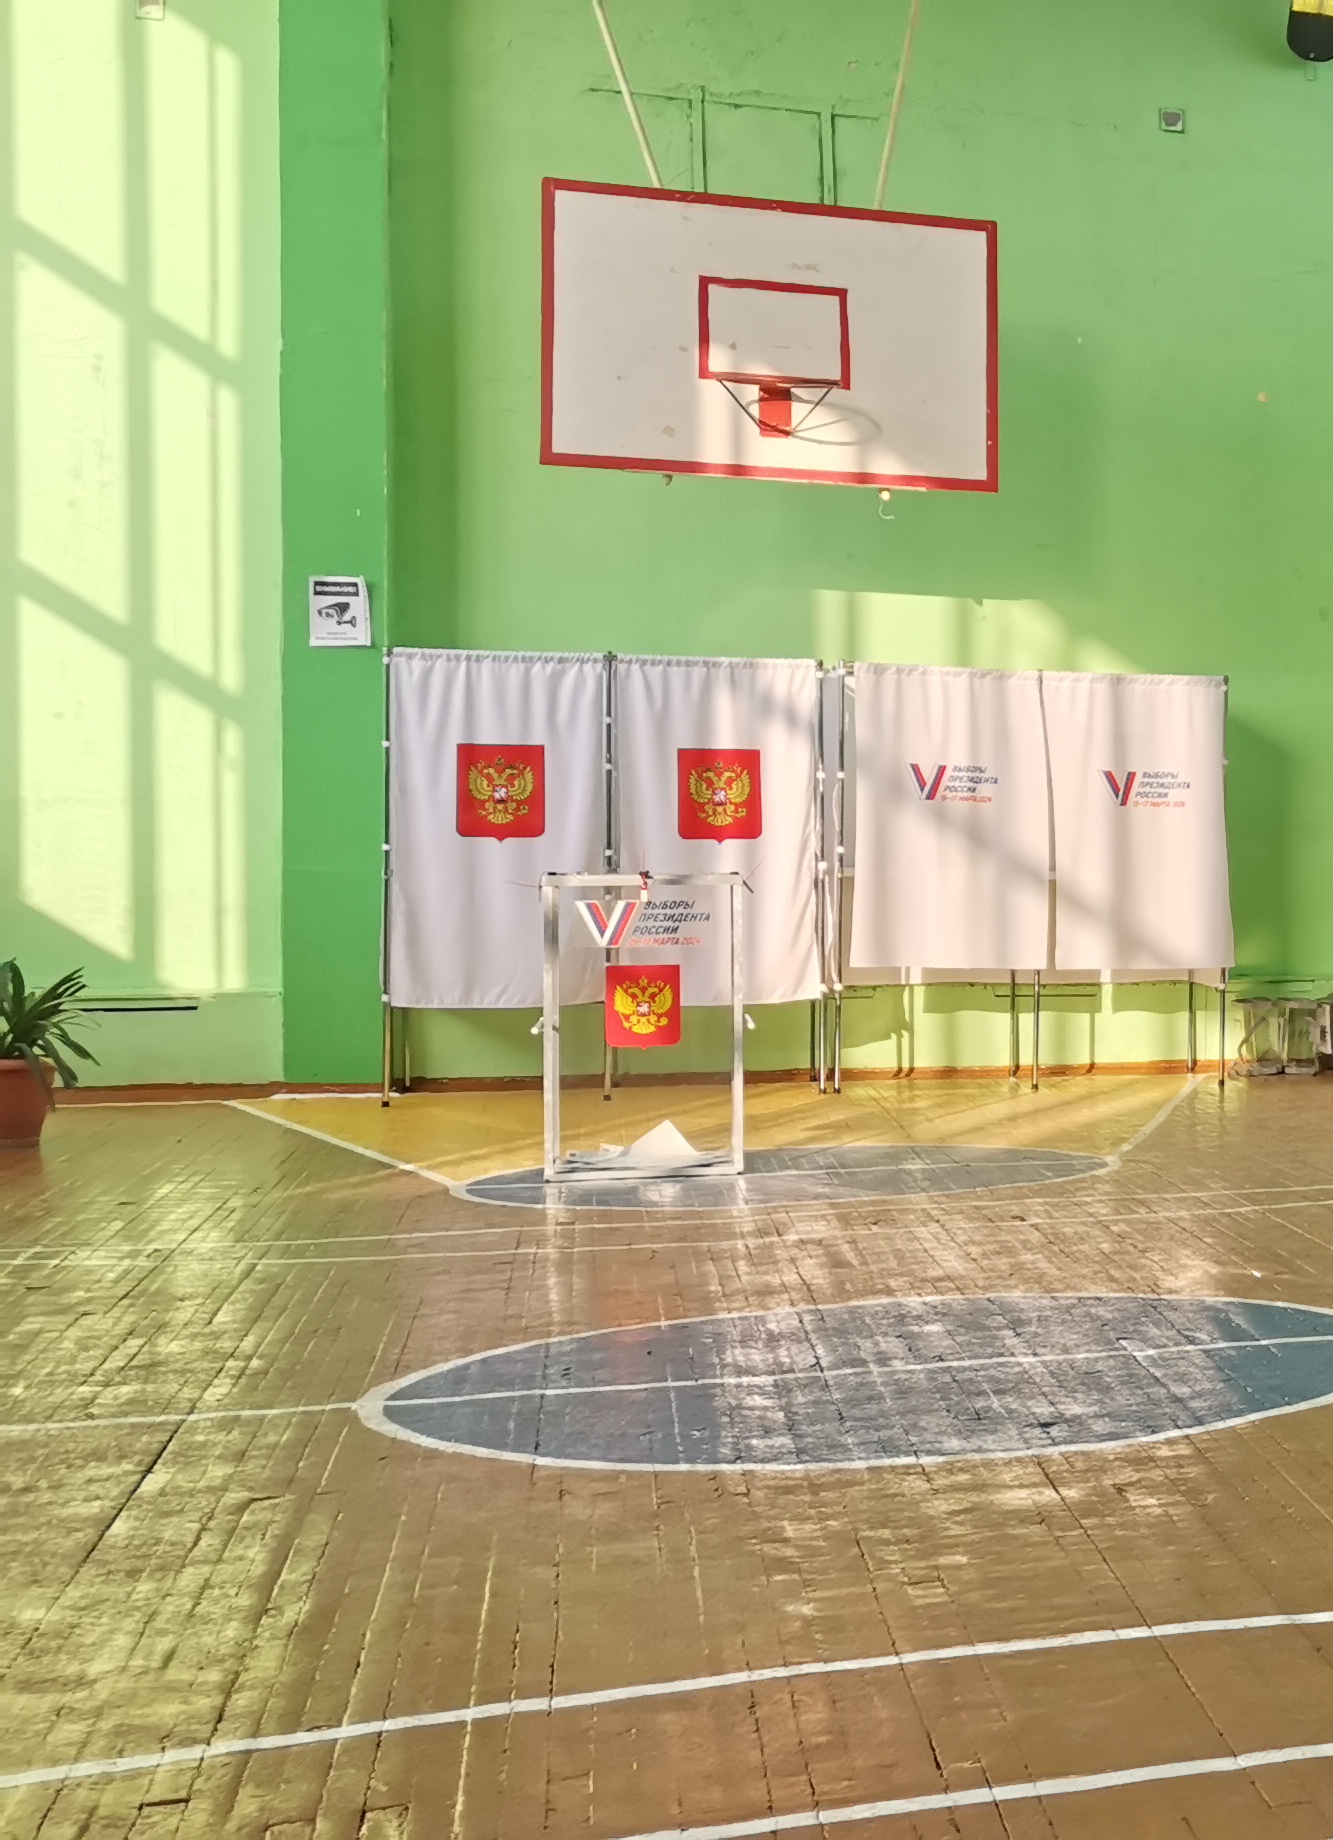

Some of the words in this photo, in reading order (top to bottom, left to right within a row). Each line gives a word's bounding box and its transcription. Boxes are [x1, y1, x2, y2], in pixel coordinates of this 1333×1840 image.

[1142, 771, 1179, 780] ВЫБОРЫ
[1138, 781, 1191, 790] ПРЕЗИДЕНТА
[1135, 791, 1169, 799] РОССИИ
[643, 900, 695, 910] ВЫБОРЫ
[638, 912, 711, 923] ПРЕЗИДЕНТА
[632, 925, 679, 936] РОССИИ
